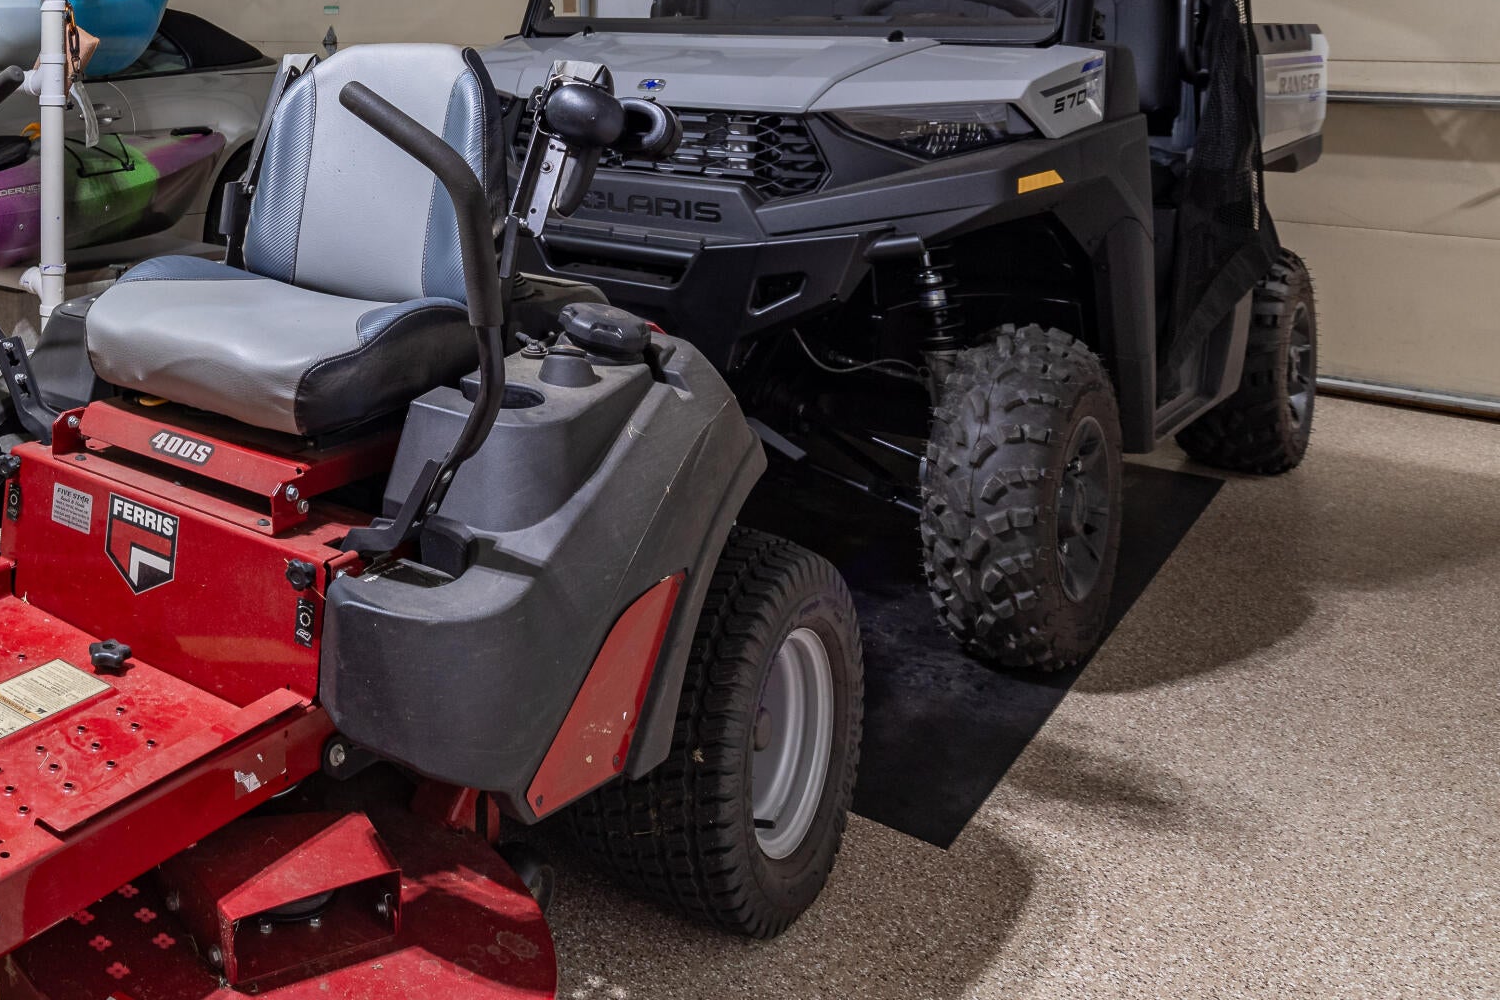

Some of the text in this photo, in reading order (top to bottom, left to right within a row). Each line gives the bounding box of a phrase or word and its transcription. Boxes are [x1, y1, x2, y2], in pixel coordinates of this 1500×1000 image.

[1278, 73, 1320, 95] RANGER
[1053, 88, 1087, 114] 570
[582, 190, 722, 223] OLARIS
[151, 431, 211, 464] 400S
[113, 498, 175, 537] FERRIS
